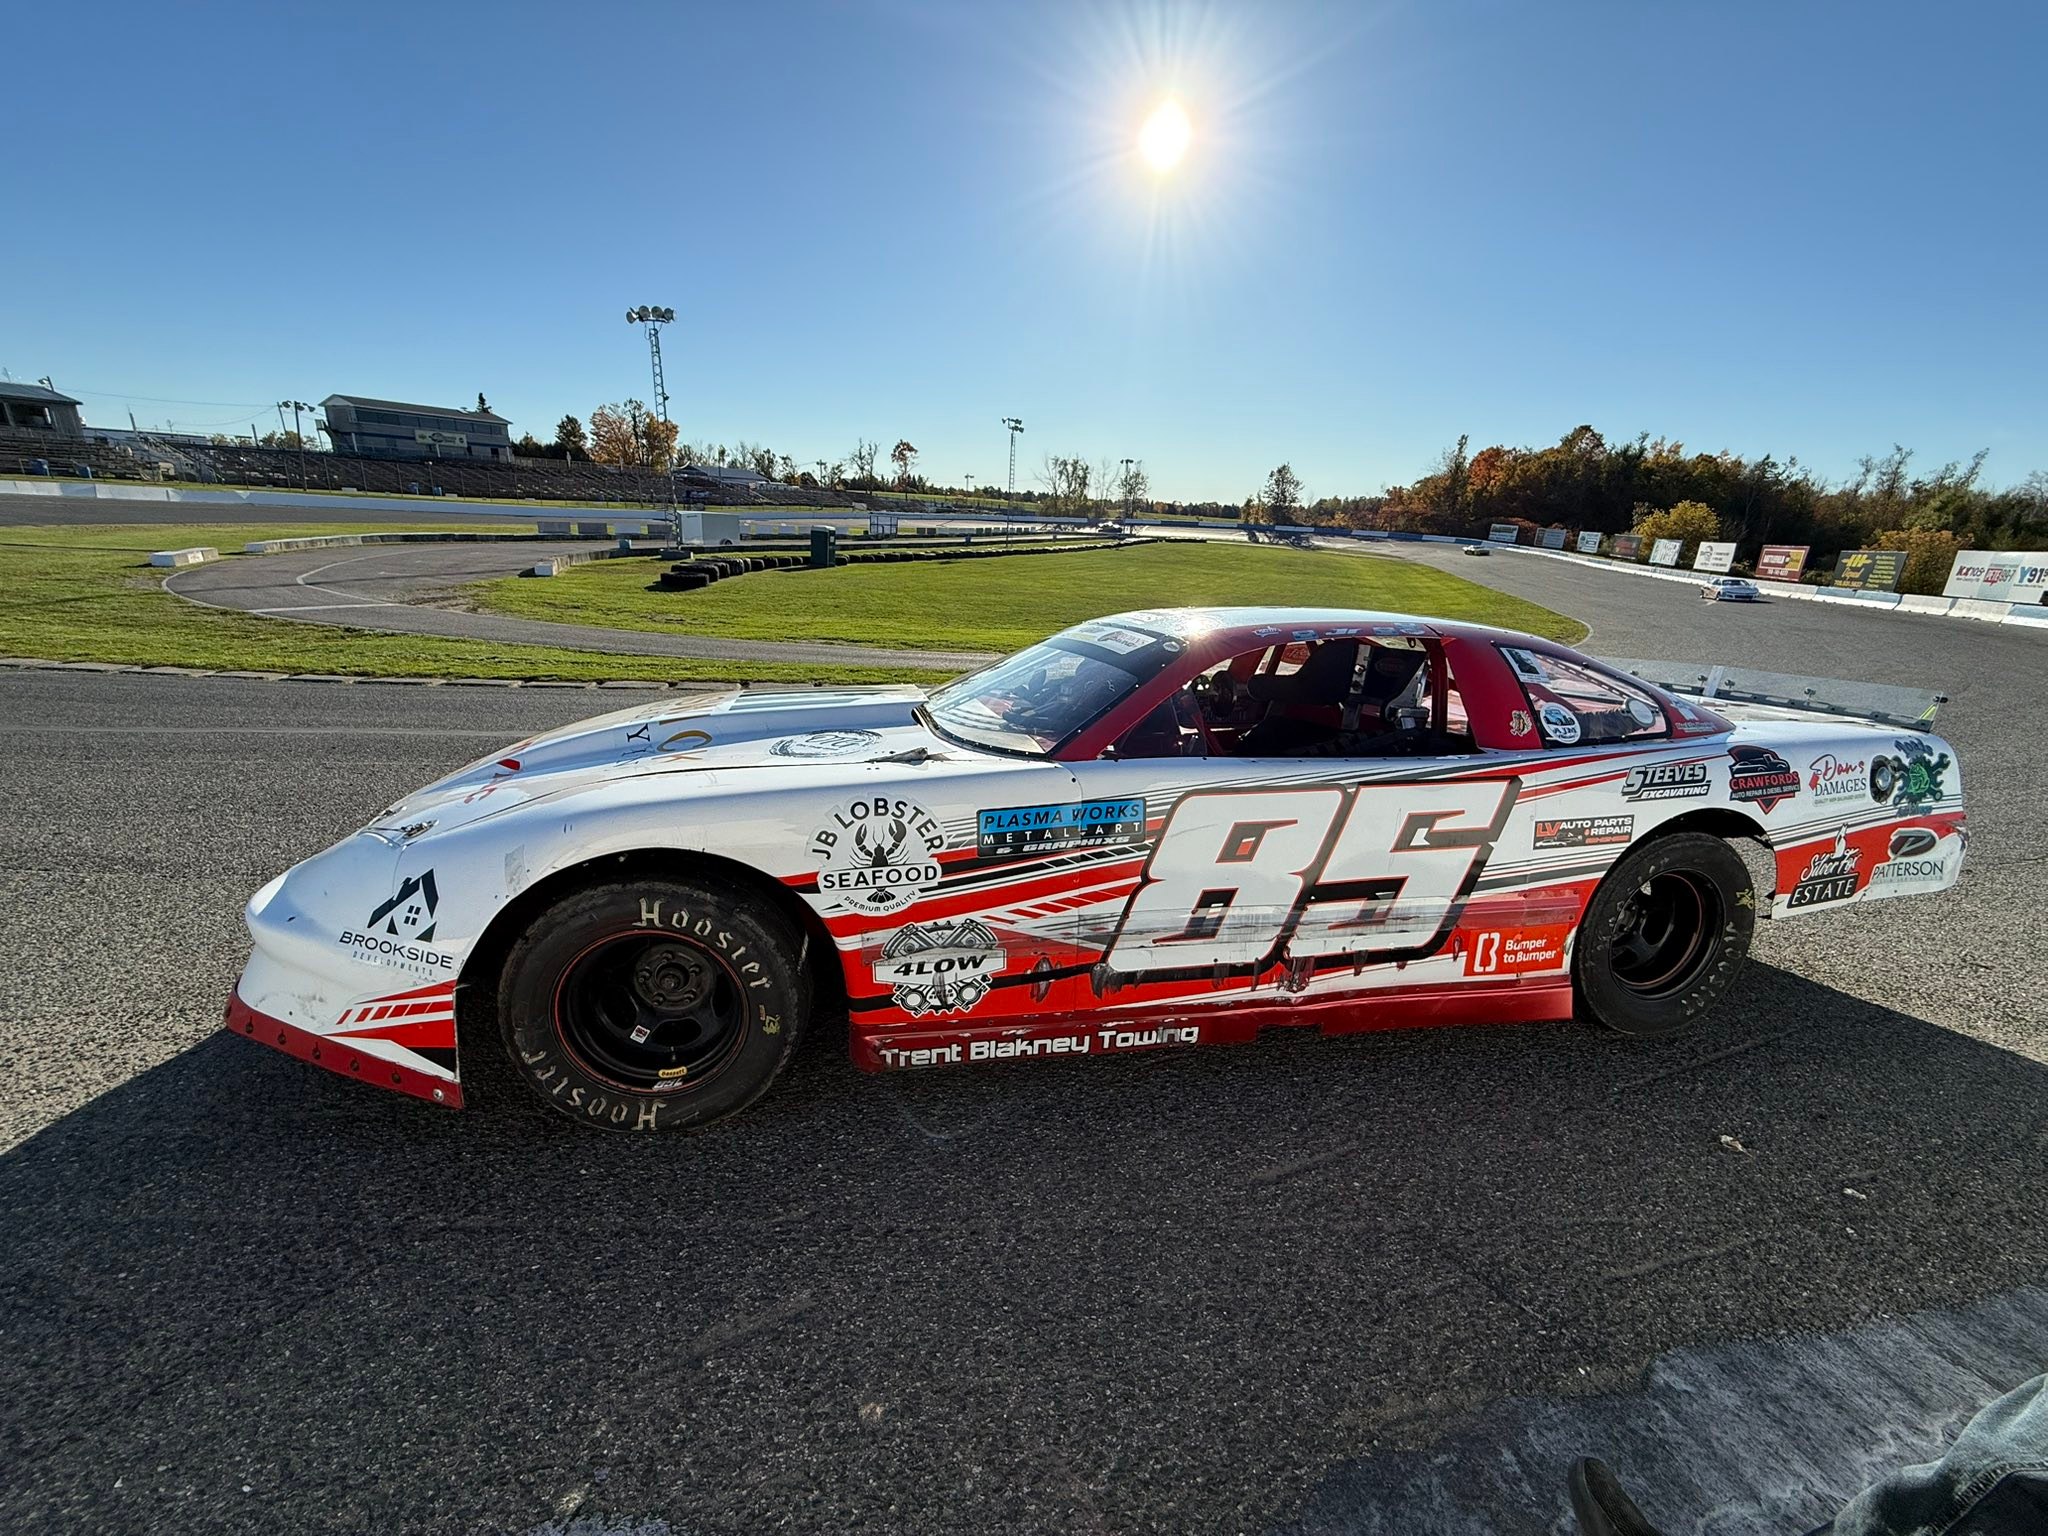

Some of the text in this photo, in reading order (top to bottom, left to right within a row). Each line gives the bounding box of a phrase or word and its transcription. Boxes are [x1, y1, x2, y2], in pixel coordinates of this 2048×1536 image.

[1622, 765, 1705, 793] STEEVES
[1731, 772, 1799, 790] CRAWFORDS
[1815, 778, 1867, 796] DAMAGES
[1641, 786, 1708, 799] EXCAVATING
[983, 804, 1140, 830] PLASMA WORKS
[1536, 817, 1632, 838] LV AUTO PARTS
[812, 798, 944, 861] JB LOBSTER
[983, 822, 1141, 845] METAL ART
[1590, 825, 1632, 836] REPAIR
[823, 865, 938, 889] SEAFOOD
[1104, 779, 1515, 975] 85
[1872, 860, 1944, 880] PATTERSON
[844, 890, 916, 912] PREMIUM QUALITY
[1791, 878, 1855, 906] ESTATE
[339, 931, 453, 969] BROOKSIDE
[632, 897, 774, 988] Hoosier
[1505, 938, 1547, 951] Bumper
[352, 950, 433, 976] DEVELOPMENTS
[894, 954, 988, 977] 4LOW
[1503, 949, 1556, 963] to Bumper
[879, 1025, 1200, 1067] Trent Blakney Towing
[520, 1050, 667, 1132] Hoosier
